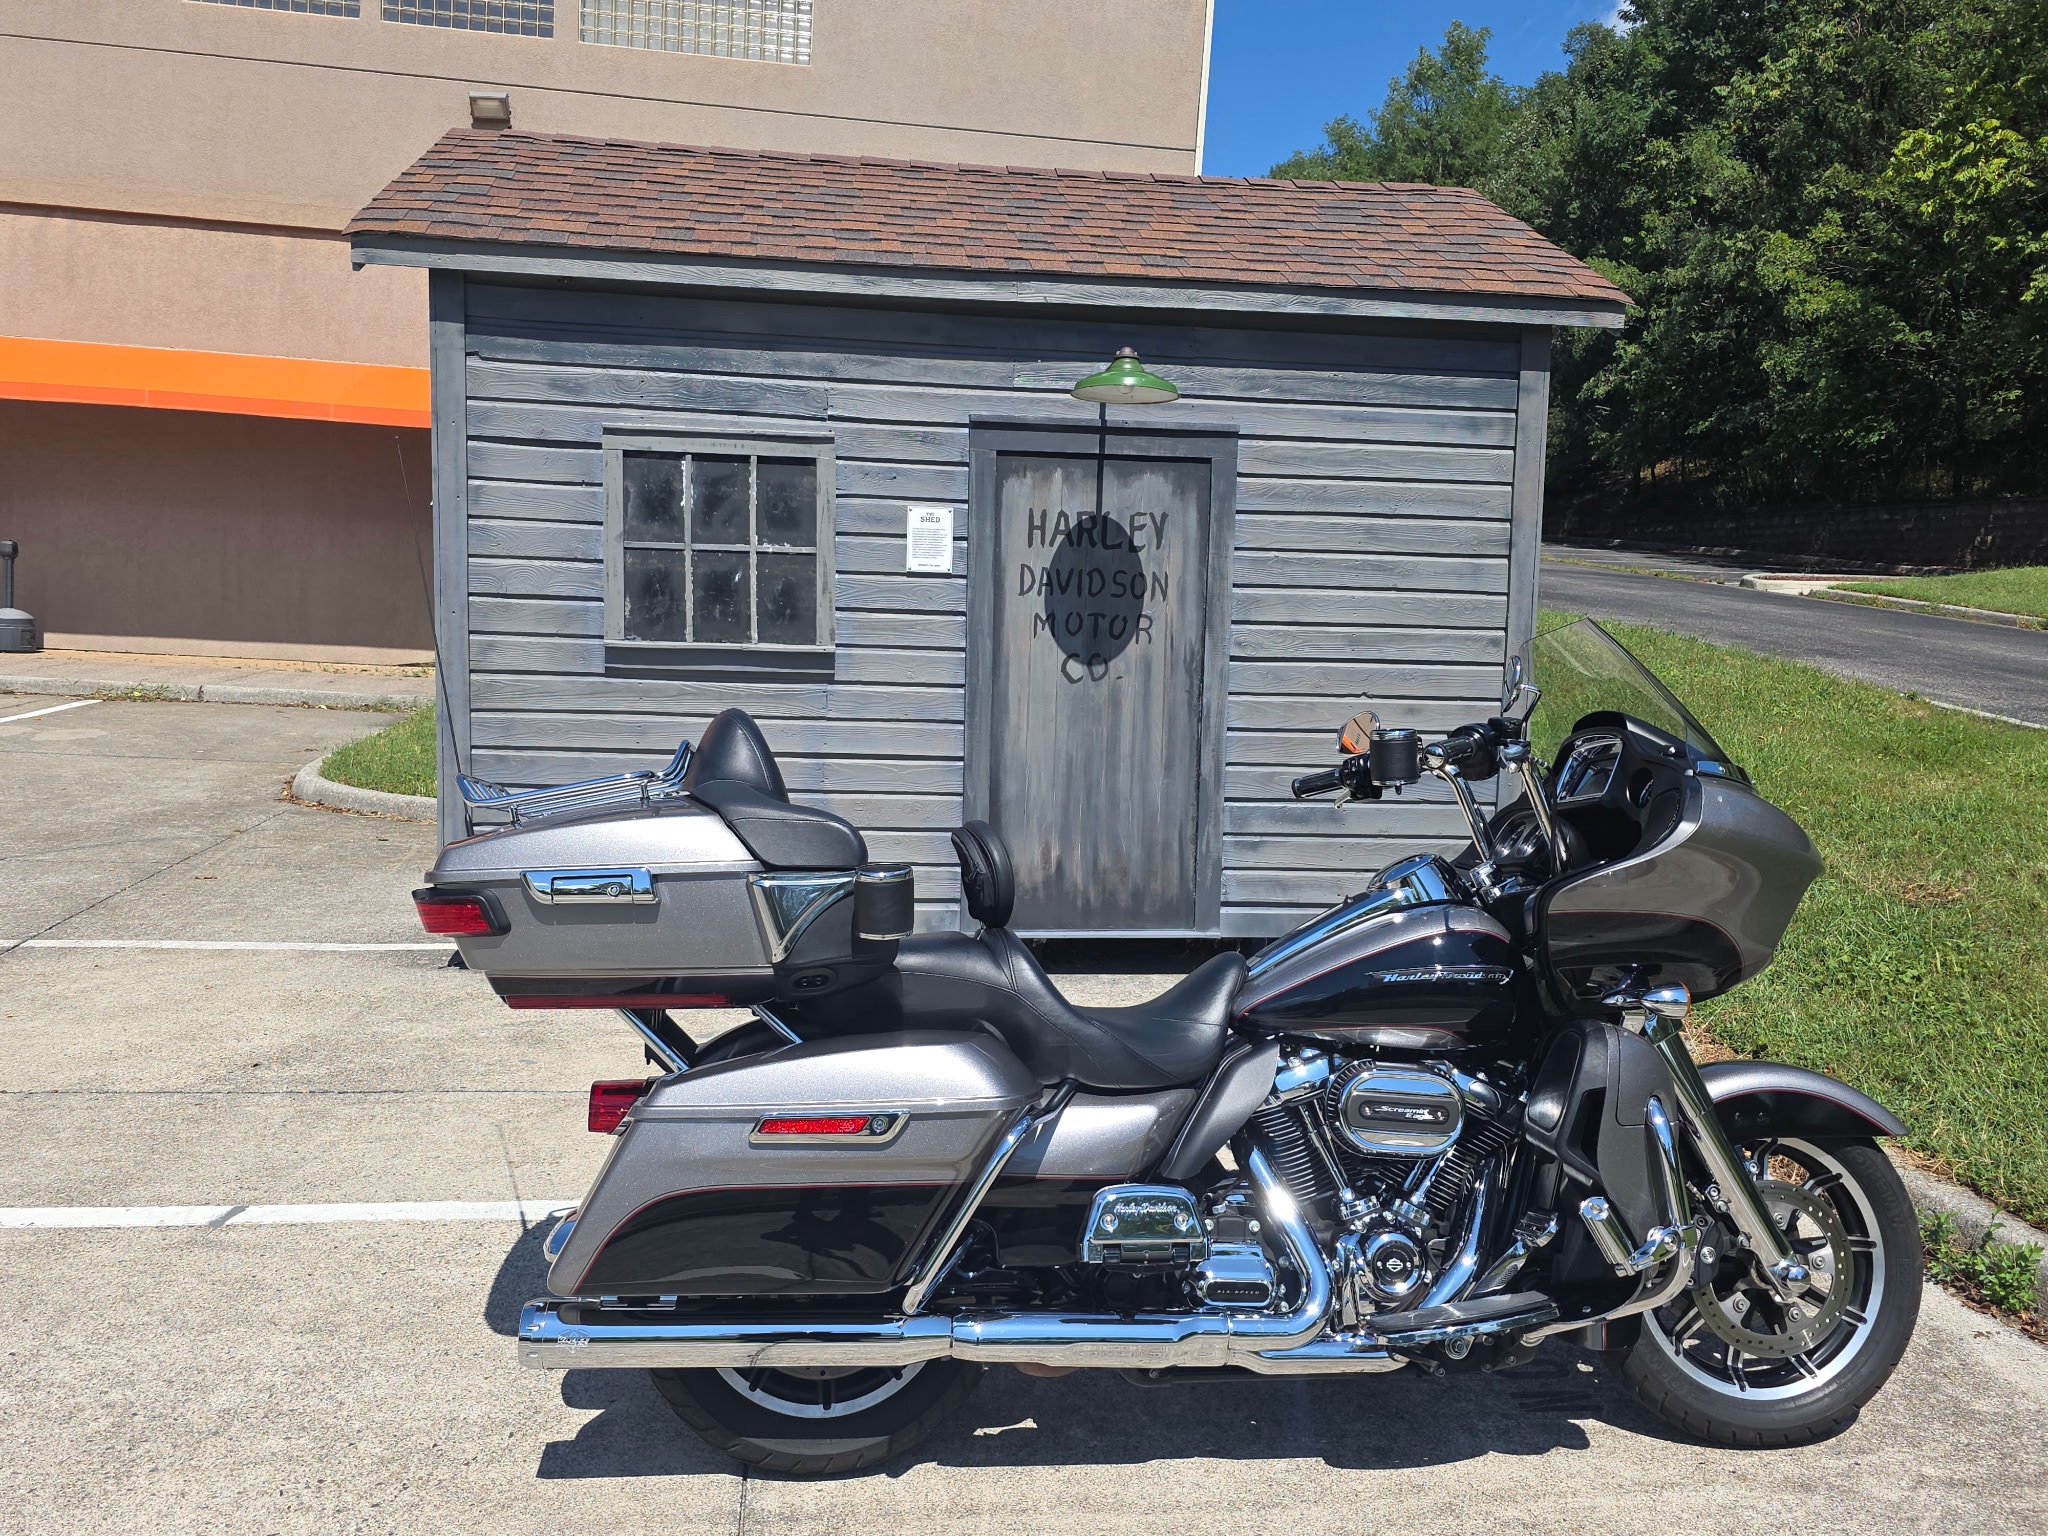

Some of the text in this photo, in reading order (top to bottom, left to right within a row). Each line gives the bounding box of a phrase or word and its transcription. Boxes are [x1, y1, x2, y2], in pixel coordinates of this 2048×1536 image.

[1027, 507, 1169, 553] HARLEY
[1018, 563, 1169, 602] DAVIDSON
[1033, 611, 1154, 645] MOTOR
